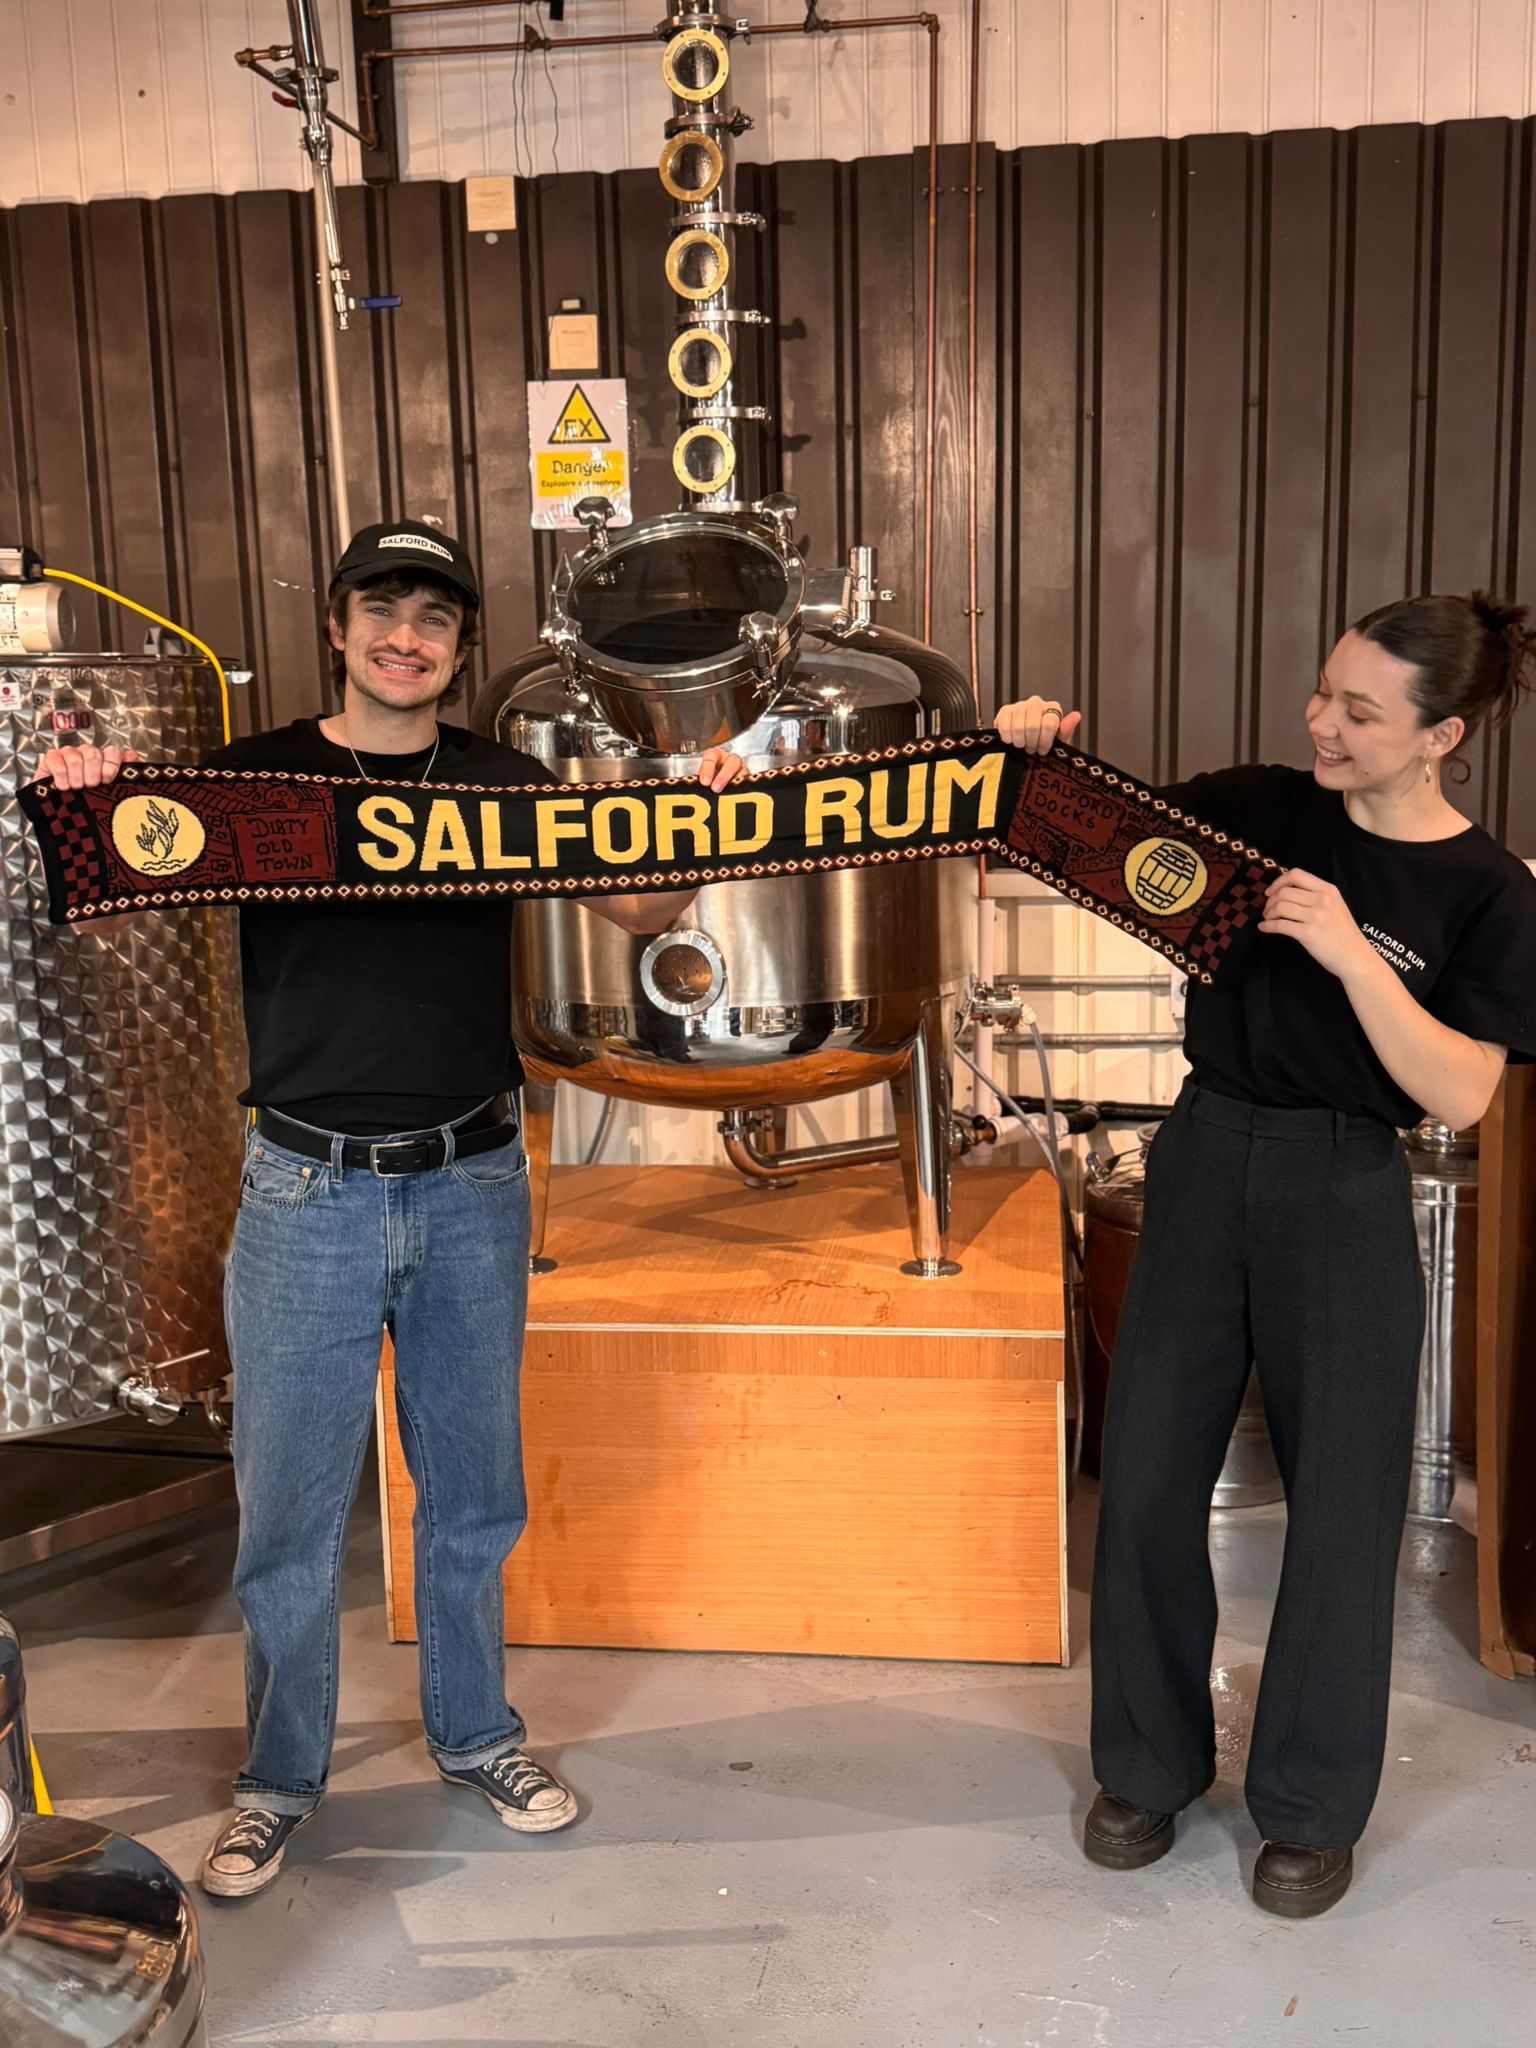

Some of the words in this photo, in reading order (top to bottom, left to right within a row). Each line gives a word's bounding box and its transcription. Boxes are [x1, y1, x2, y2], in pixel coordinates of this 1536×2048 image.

[564, 418, 593, 437] EX
[553, 460, 607, 476] Danger
[381, 537, 428, 547] SALFORD
[1038, 772, 1114, 819] SALFORD
[357, 791, 774, 871] SALFORD
[805, 752, 1005, 847] RUM
[1035, 793, 1096, 829] DOCKS
[246, 818, 309, 838] DIRTY
[256, 838, 293, 855] OLD
[256, 856, 314, 872] TOWN
[1361, 923, 1405, 953] SALFORD
[1405, 950, 1426, 971] RUM
